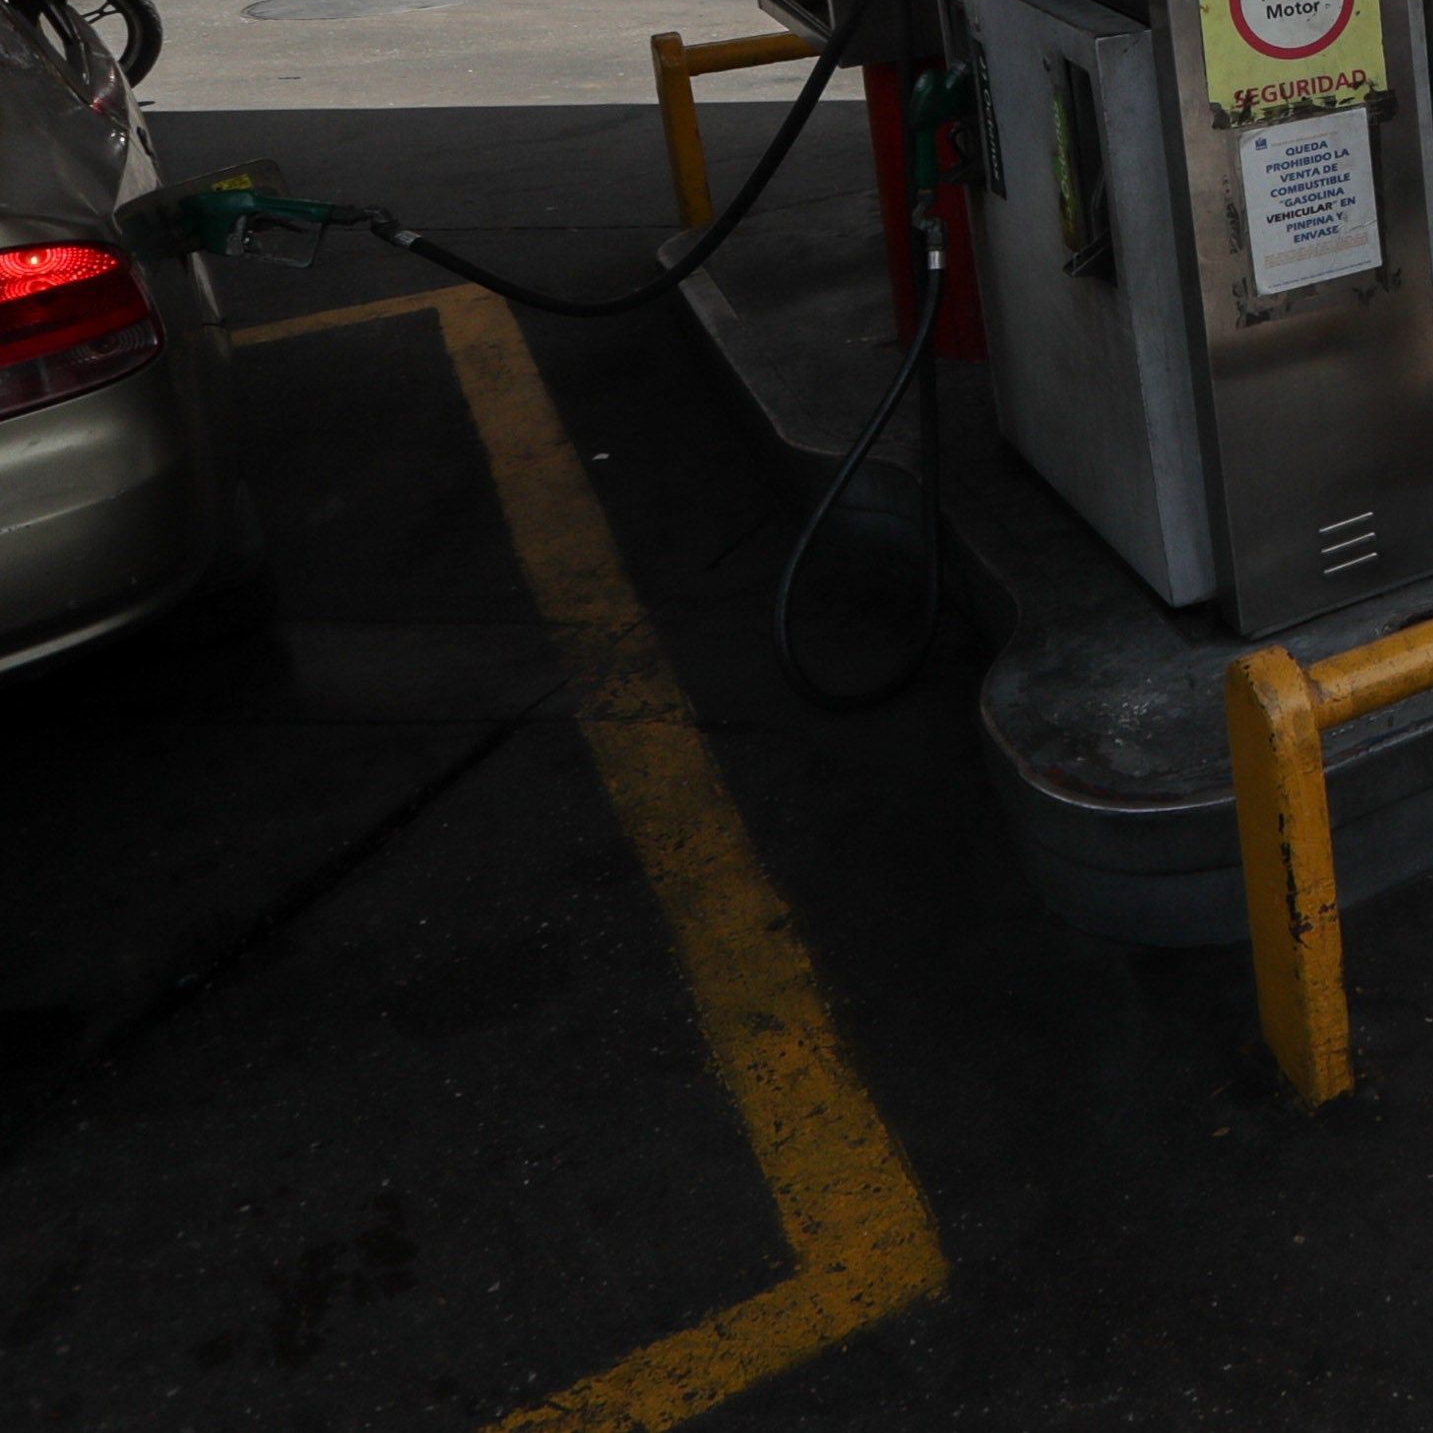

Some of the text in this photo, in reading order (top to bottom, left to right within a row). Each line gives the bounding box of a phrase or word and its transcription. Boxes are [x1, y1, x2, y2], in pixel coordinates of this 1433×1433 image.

[1265, 0, 1321, 20] Motor
[1233, 69, 1368, 109] SEGURIDAD
[1285, 140, 1328, 157] QUEDA
[1265, 148, 1350, 174] PROHIBIDO LA
[1280, 163, 1339, 183] VENTA DE
[1270, 172, 1351, 198] COMBUSTIBLE
[1340, 196, 1356, 208] EN
[1286, 212, 1344, 233] PINPINA Y
[1293, 225, 1340, 244] ENVASE
